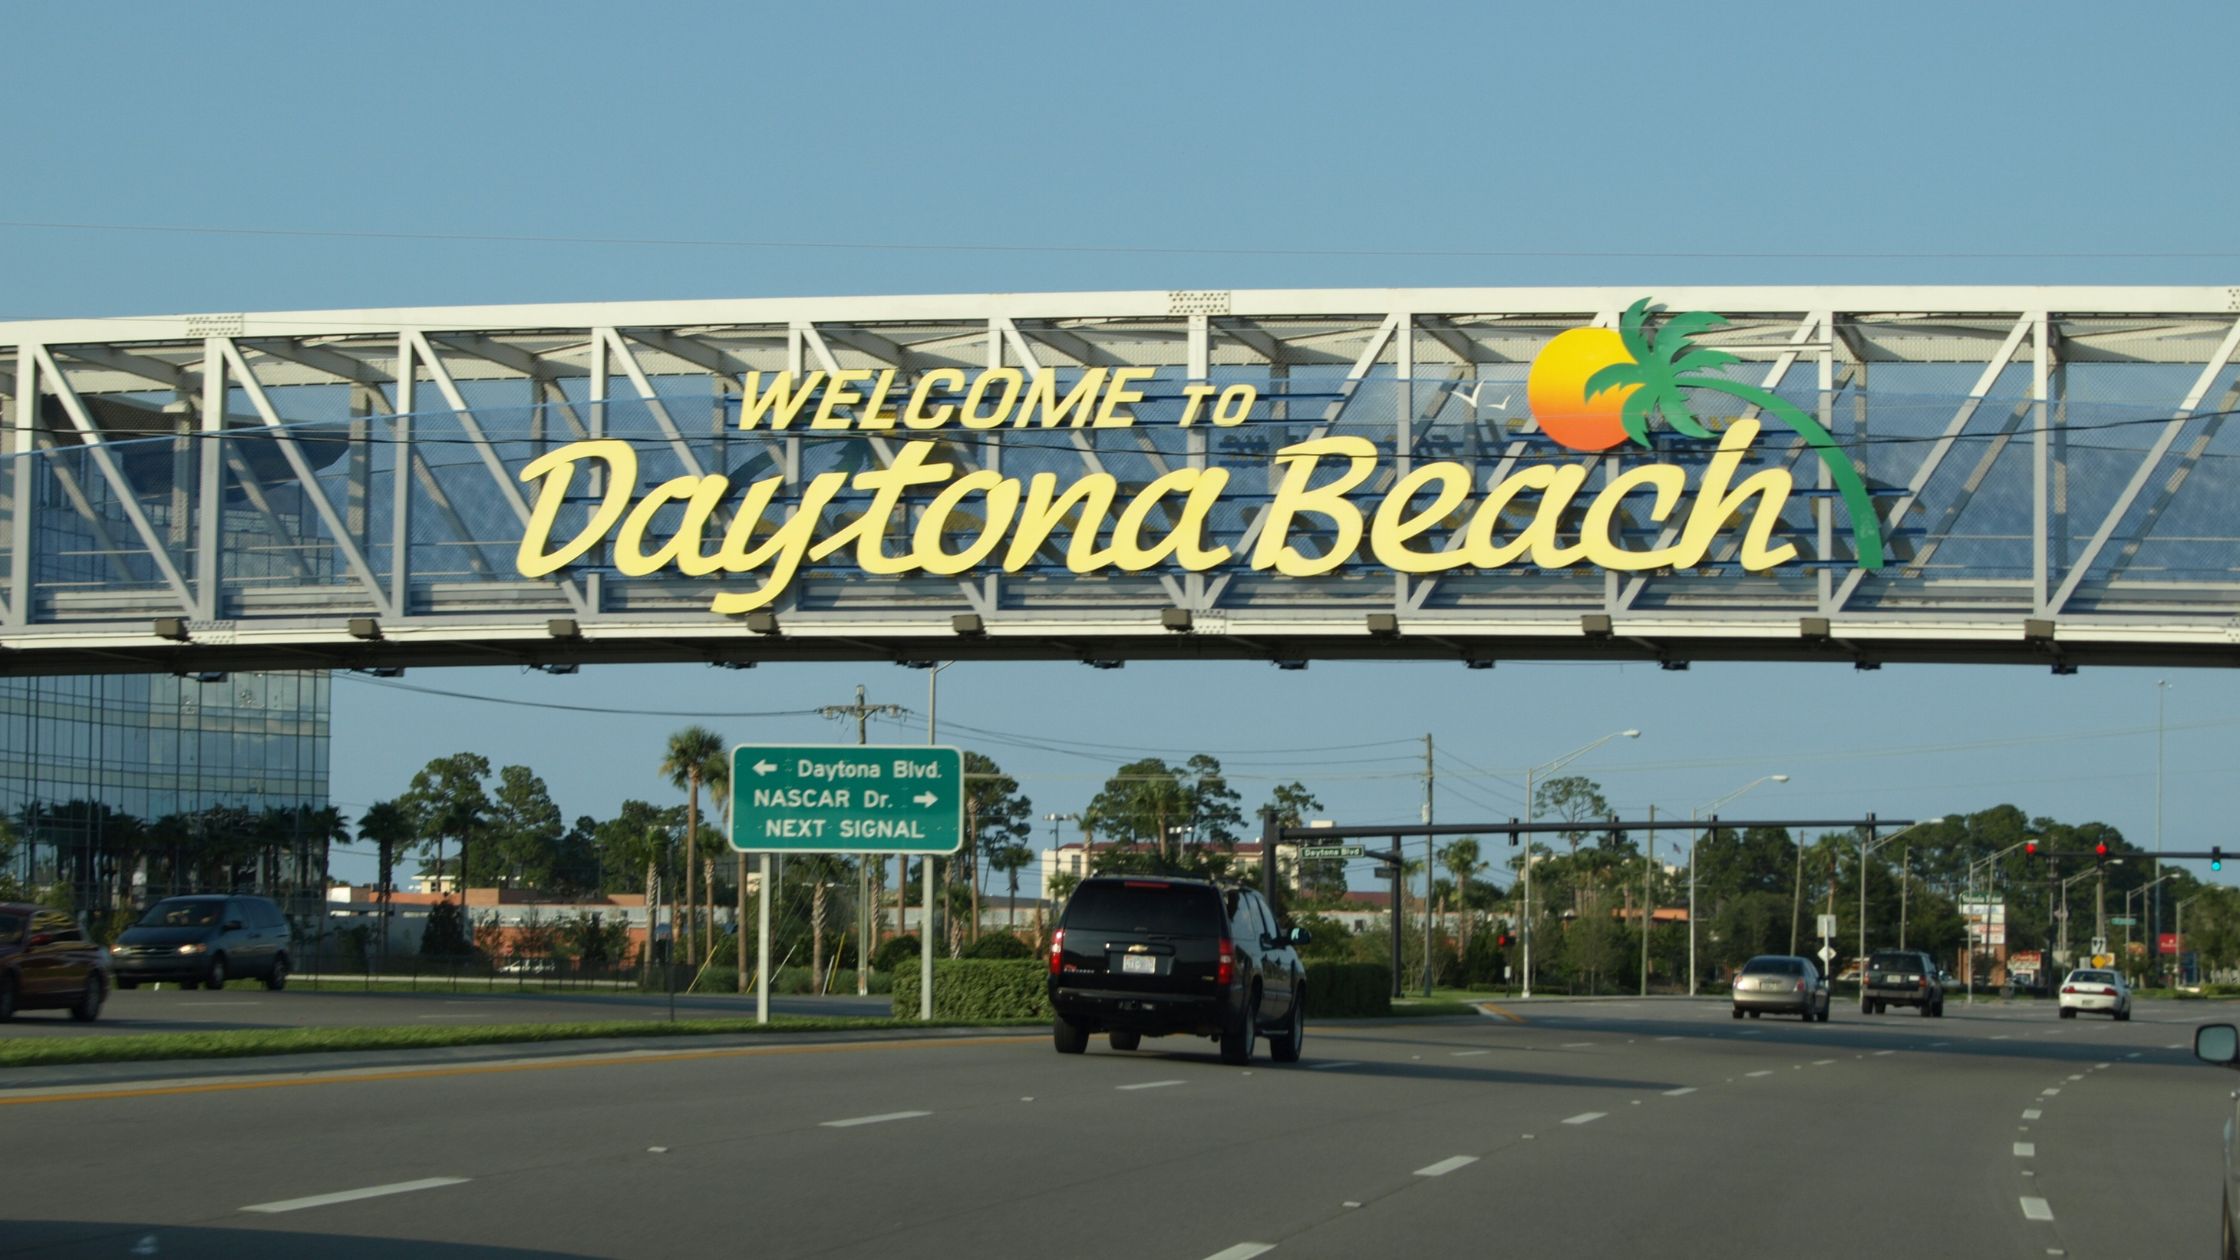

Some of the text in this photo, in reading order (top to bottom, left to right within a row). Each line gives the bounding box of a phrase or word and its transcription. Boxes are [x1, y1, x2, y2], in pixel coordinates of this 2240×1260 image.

[738, 367, 1257, 430] WELCOME TO
[517, 418, 1798, 614] Daytona Beach
[798, 759, 942, 781] Daytona Blvd.
[754, 788, 893, 808] NASCAR Dr.
[765, 819, 925, 839] NEXT SIGNAL
[1305, 849, 1339, 857] Daytona
